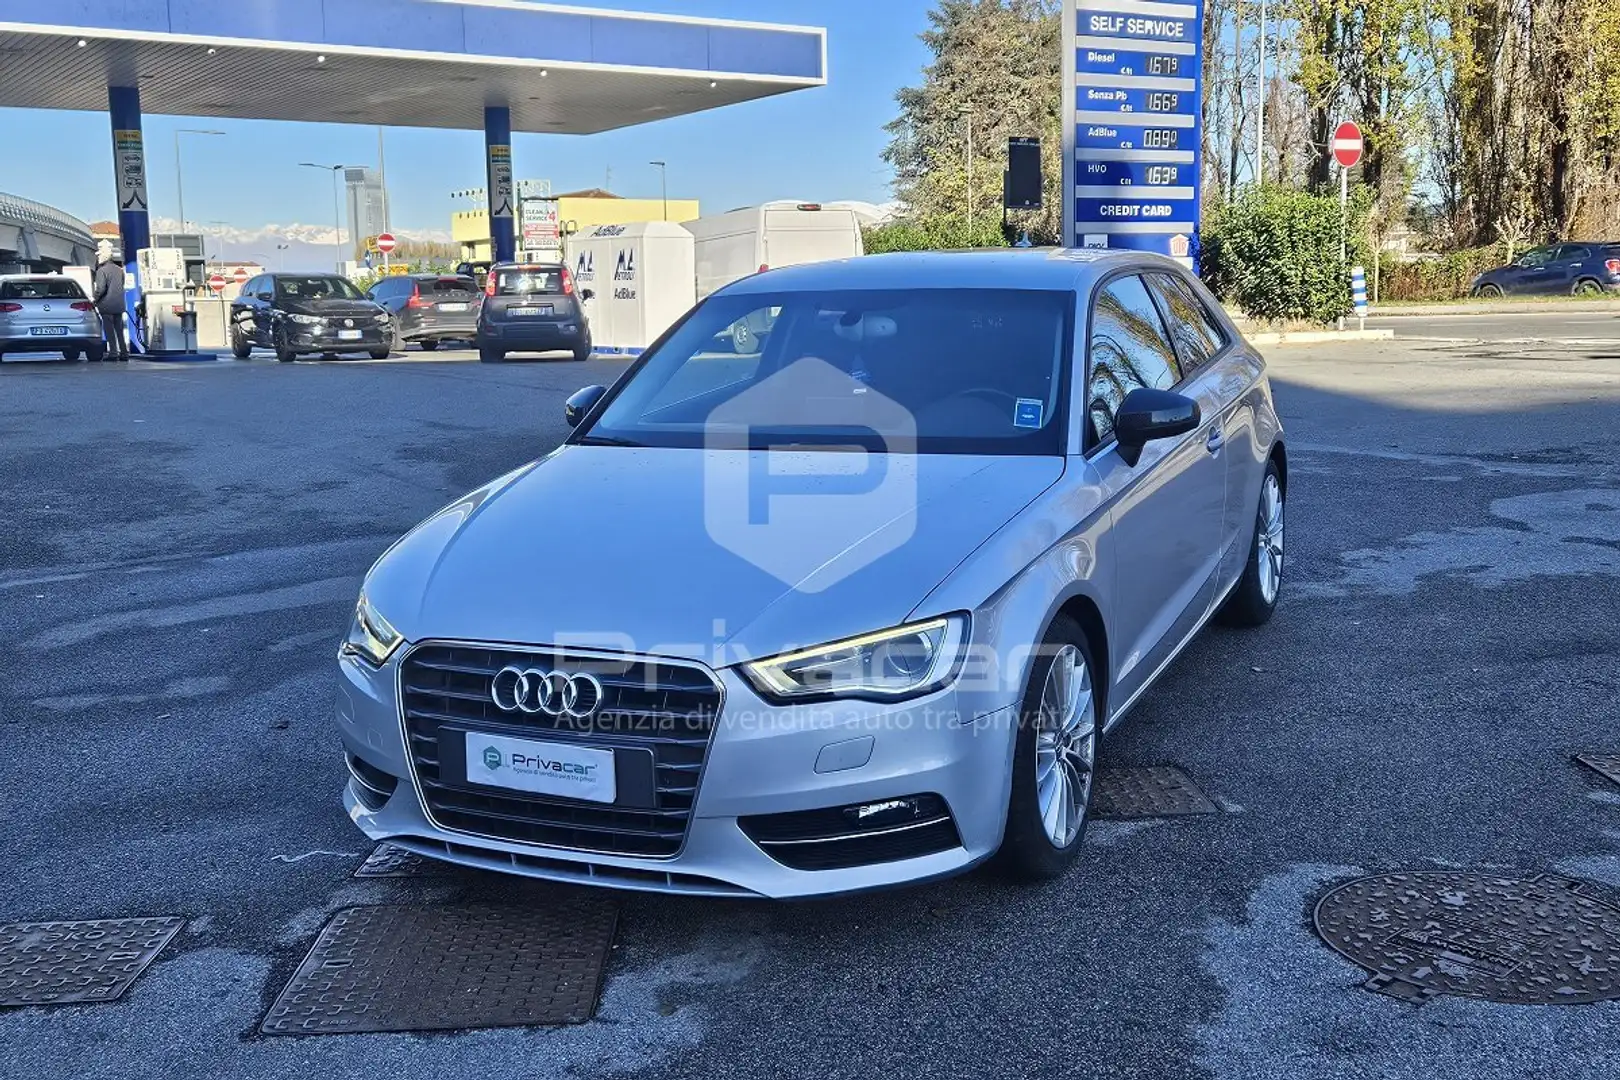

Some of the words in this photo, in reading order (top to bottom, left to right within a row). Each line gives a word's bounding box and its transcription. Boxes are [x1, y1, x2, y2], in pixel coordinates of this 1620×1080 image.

[1090, 16, 1124, 32] SELF
[1127, 18, 1184, 37] SERVICE
[1088, 52, 1115, 63] Diesel
[1088, 89, 1114, 100] Senza
[1115, 91, 1128, 101] Pb
[1088, 127, 1118, 138] AdBlue
[1088, 164, 1107, 173] HVO
[1100, 204, 1140, 216] CREDIT
[1142, 205, 1172, 216] CARD
[614, 287, 636, 300] AdBlue
[512, 753, 597, 774] Privacar
